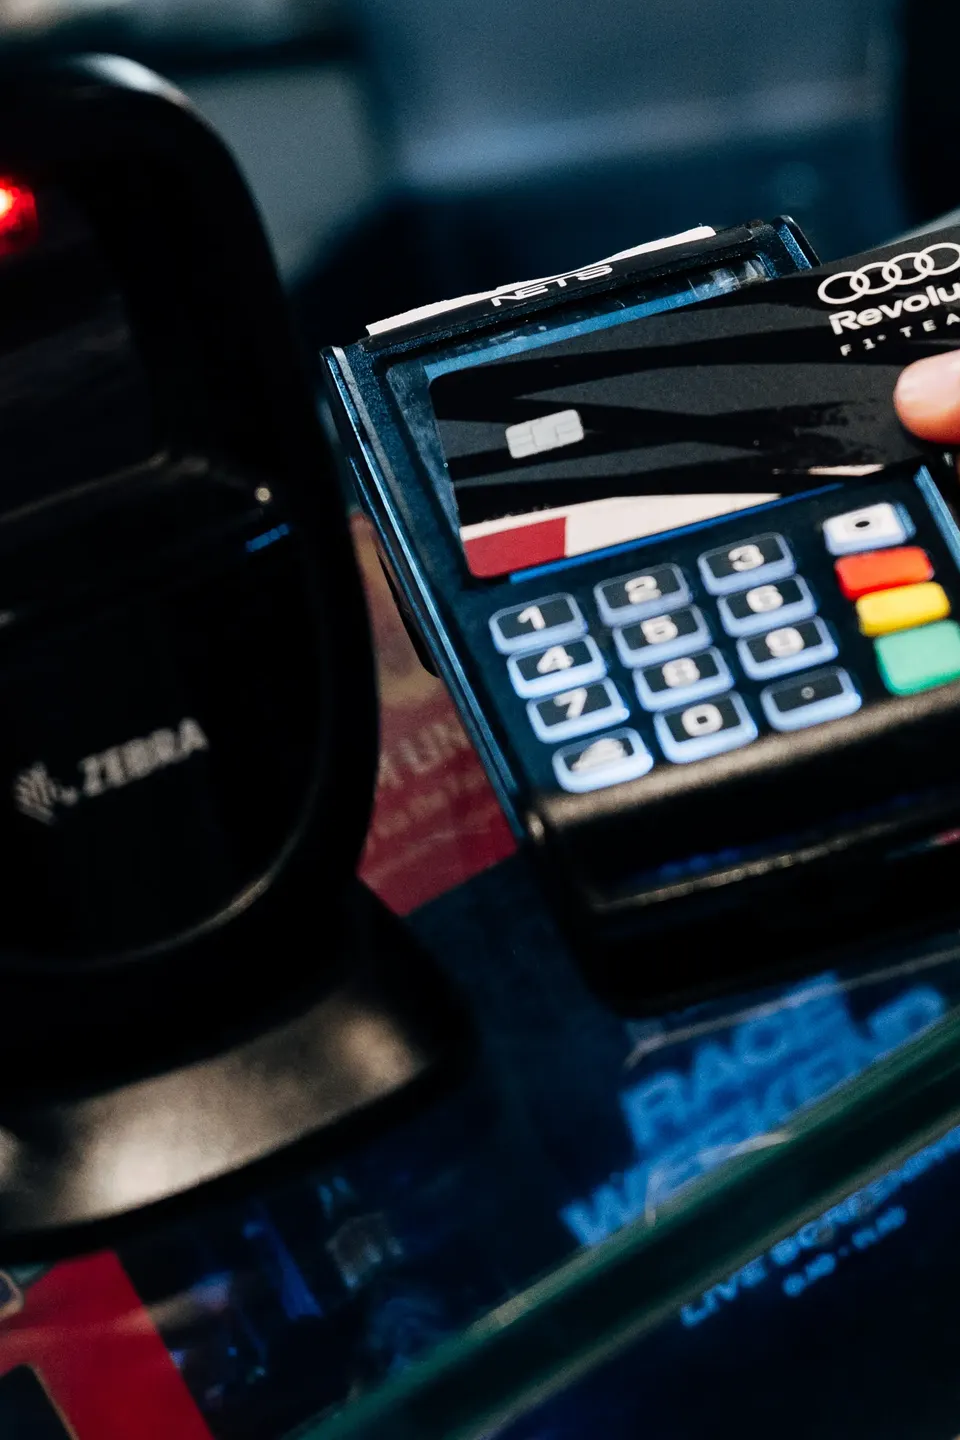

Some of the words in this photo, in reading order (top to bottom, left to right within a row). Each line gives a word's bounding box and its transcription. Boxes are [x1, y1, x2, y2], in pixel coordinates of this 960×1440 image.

[490, 264, 613, 307] NETS
[517, 605, 546, 630] 1
[624, 575, 662, 604] 2
[727, 543, 765, 572] 3
[536, 645, 574, 674] 4
[640, 615, 679, 646] 5
[745, 584, 784, 614] 6
[553, 686, 588, 720] 7
[661, 656, 701, 689] 8
[765, 626, 805, 658] 9
[81, 717, 209, 797] ZEBRA
[680, 702, 724, 738] 0
[618, 969, 850, 1151] RACE
